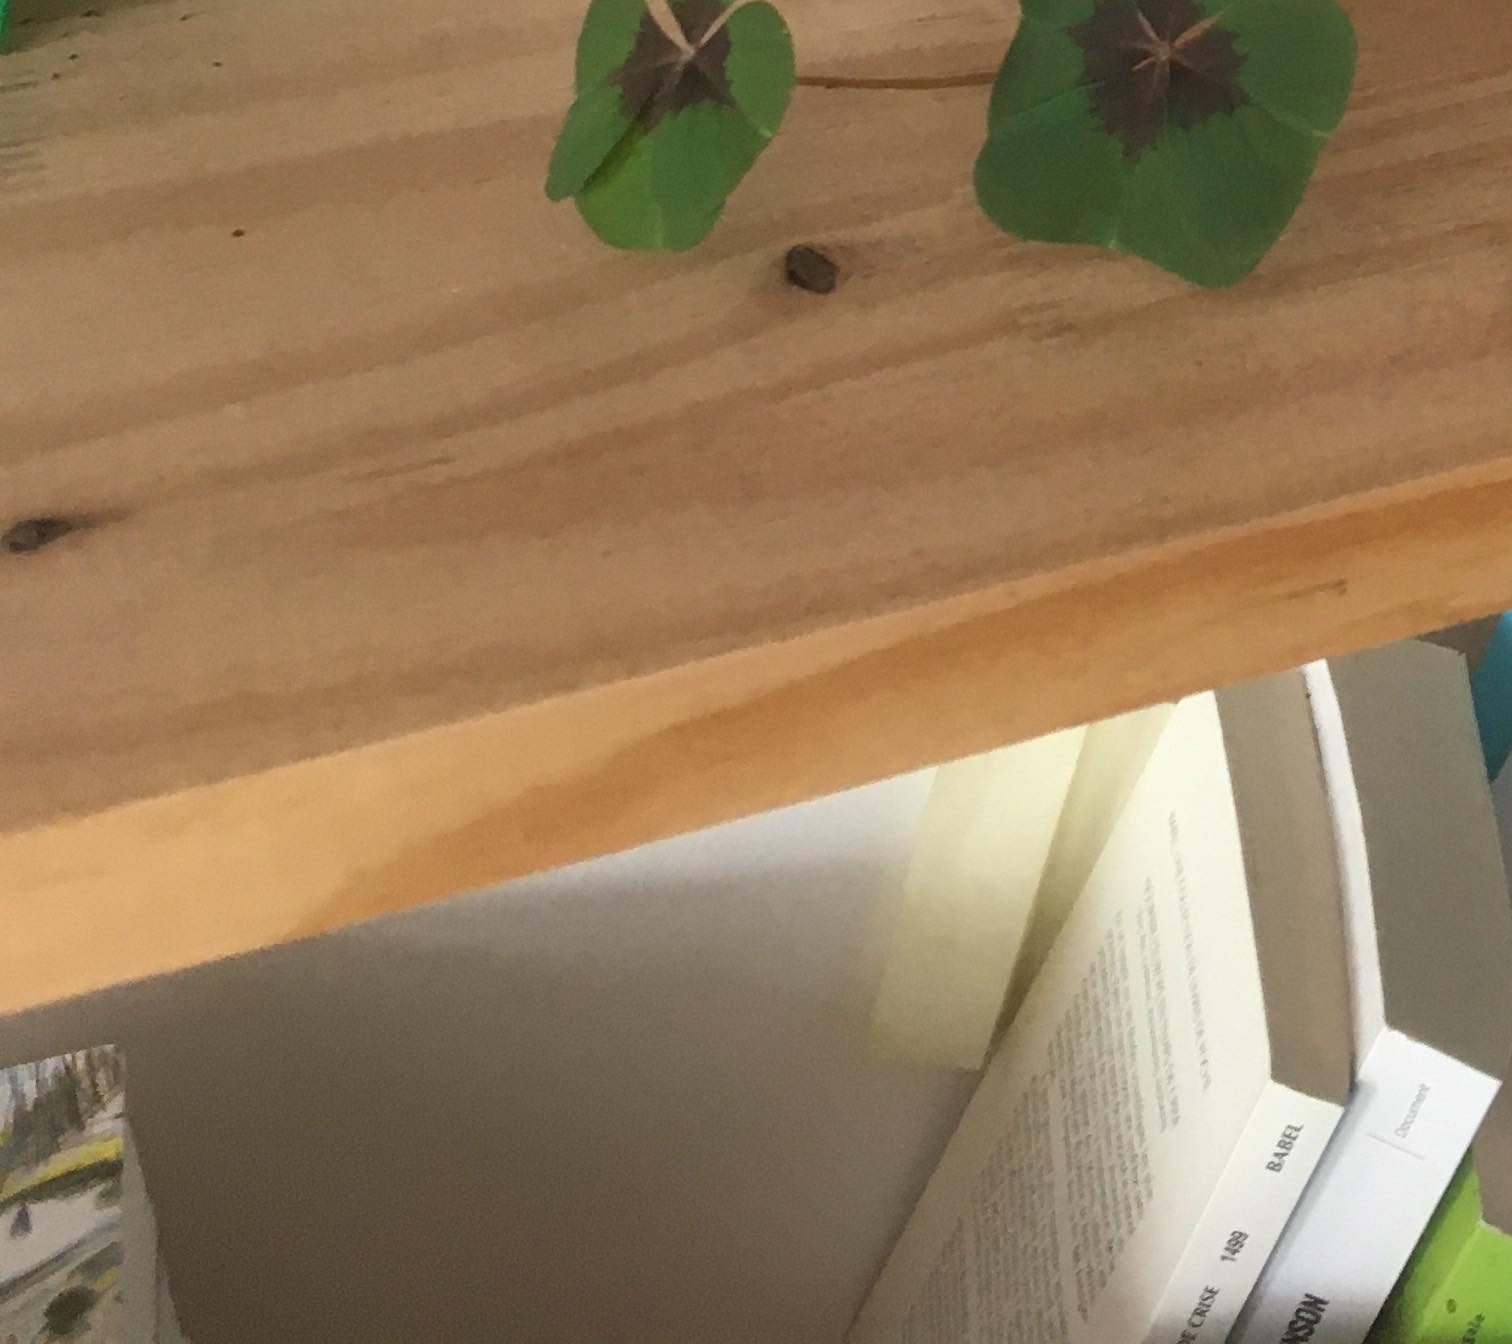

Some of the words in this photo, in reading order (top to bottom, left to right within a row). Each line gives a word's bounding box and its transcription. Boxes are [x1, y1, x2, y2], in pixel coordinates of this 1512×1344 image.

[1393, 1082, 1433, 1139] Document
[1188, 1284, 1221, 1328] CRISE
[1219, 1228, 1249, 1263] 1499
[1265, 1122, 1304, 1174] BABEL
